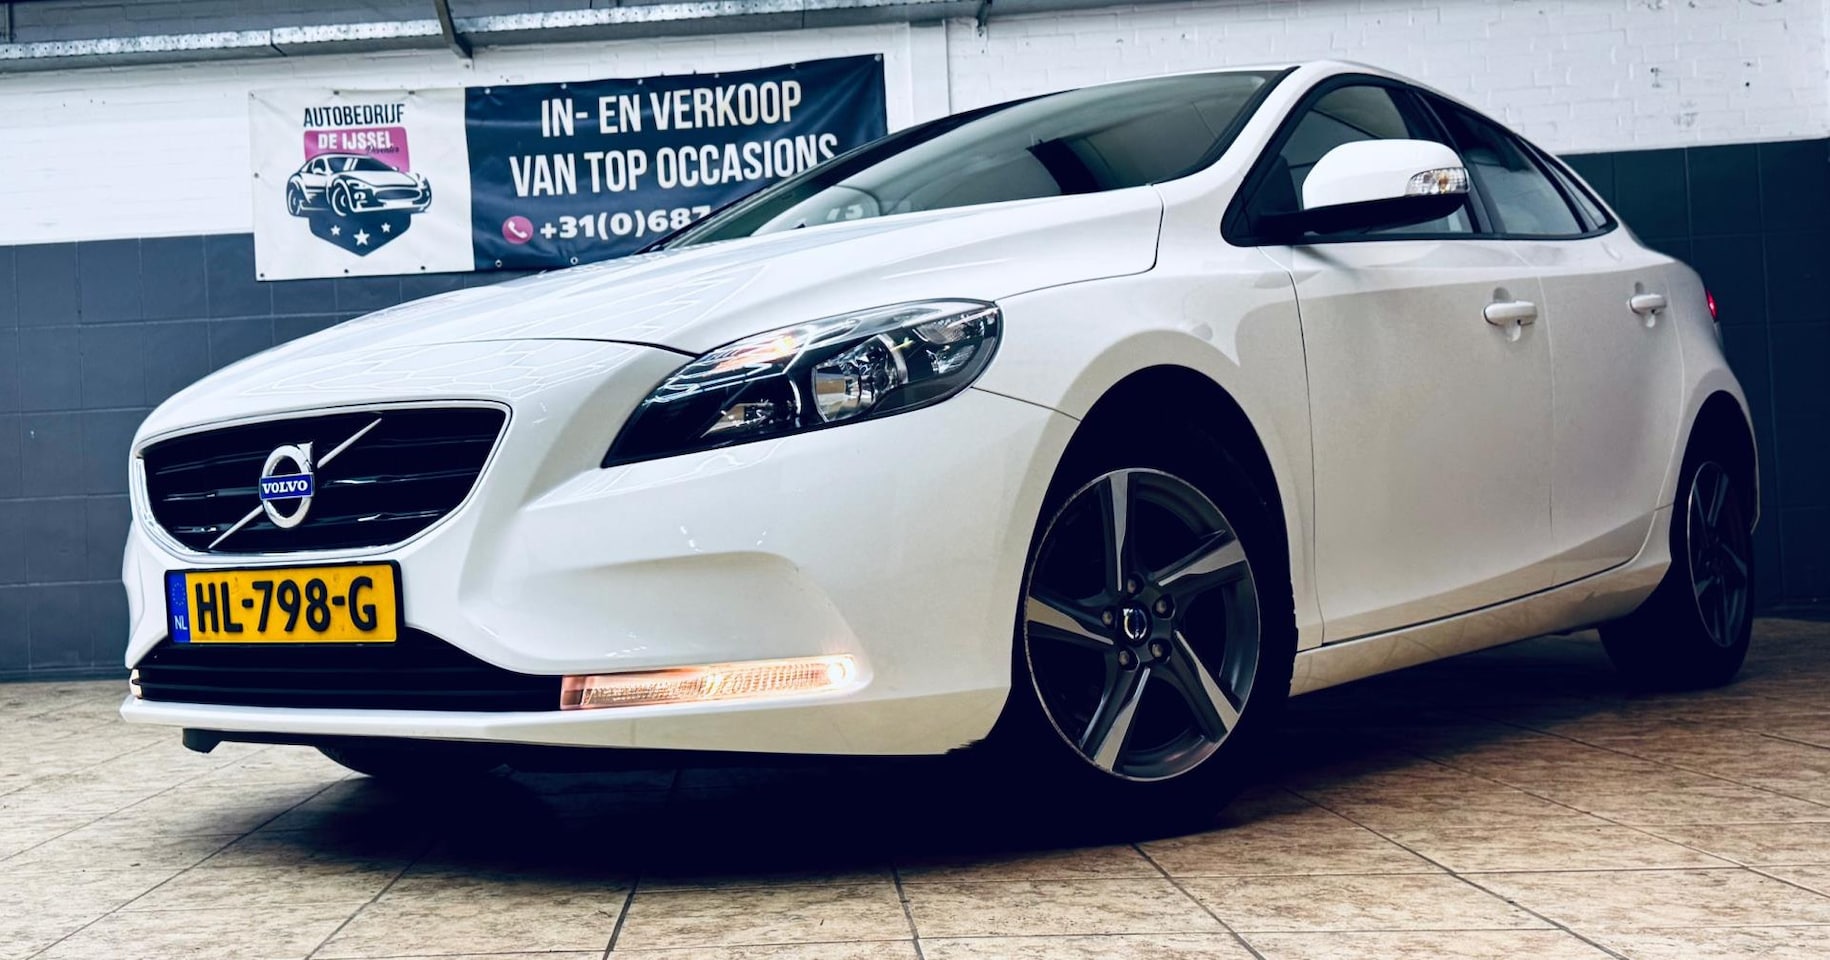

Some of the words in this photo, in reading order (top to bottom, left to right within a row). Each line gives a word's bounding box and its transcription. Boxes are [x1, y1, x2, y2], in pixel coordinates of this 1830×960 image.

[303, 103, 405, 128] AUTOBEDRIJF
[541, 98, 588, 137] IN-
[599, 95, 642, 134] EN
[649, 80, 802, 131] VERKOOP
[318, 133, 337, 150] DE
[341, 131, 394, 150] IJSSEL
[509, 153, 577, 197] VAN
[583, 149, 648, 193] TOP
[262, 480, 308, 494] VOLVO
[195, 576, 378, 633] HL-798-G
[174, 615, 188, 630] NL
